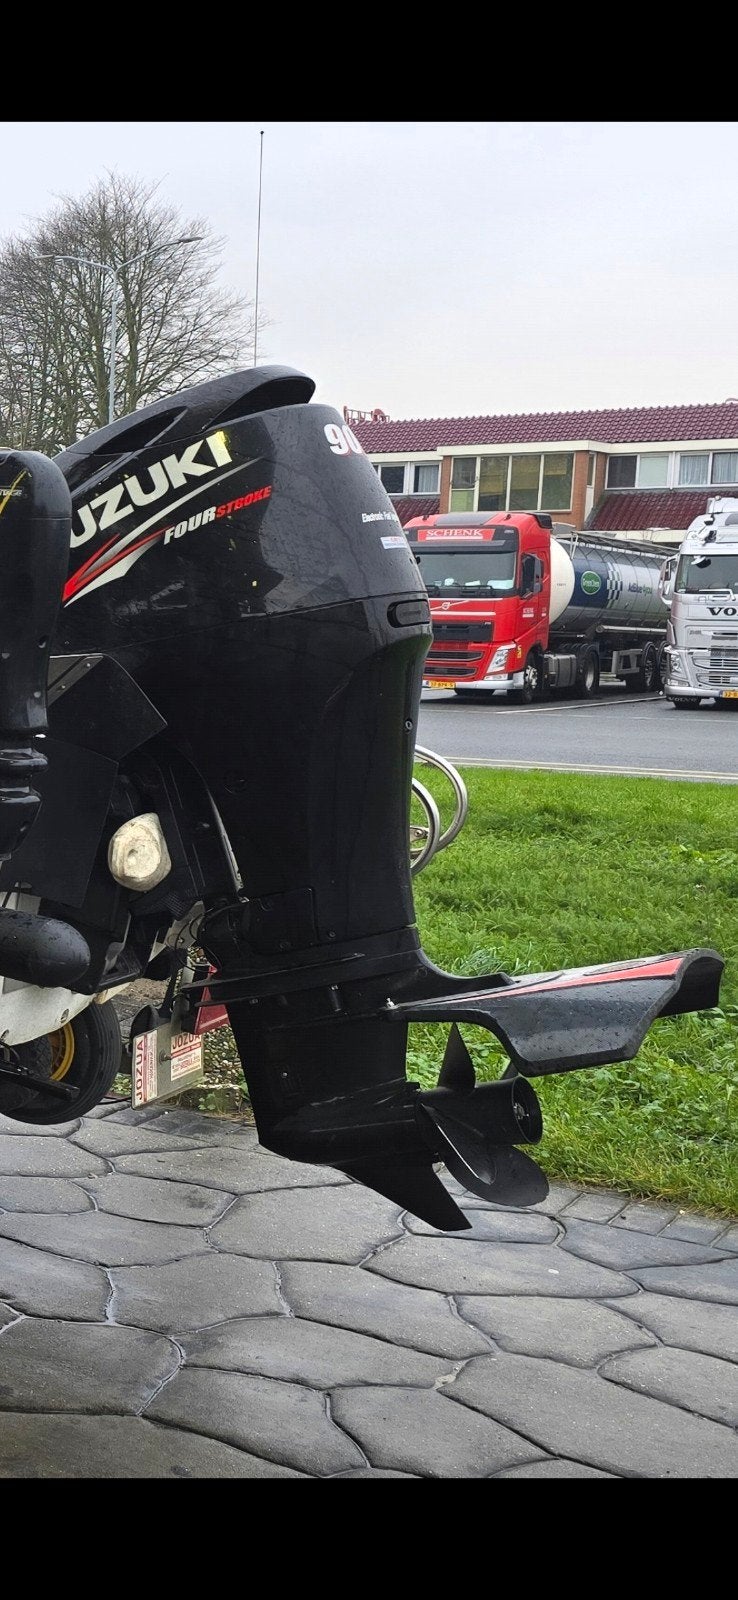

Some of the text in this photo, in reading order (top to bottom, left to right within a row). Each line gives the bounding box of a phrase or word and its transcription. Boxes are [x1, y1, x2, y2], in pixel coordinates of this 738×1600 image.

[323, 423, 364, 455] 90
[69, 430, 233, 549] UZUKI
[706, 606, 738, 617] VO
[172, 1033, 200, 1049] JOZUA
[136, 1040, 144, 1100] JOZUA
